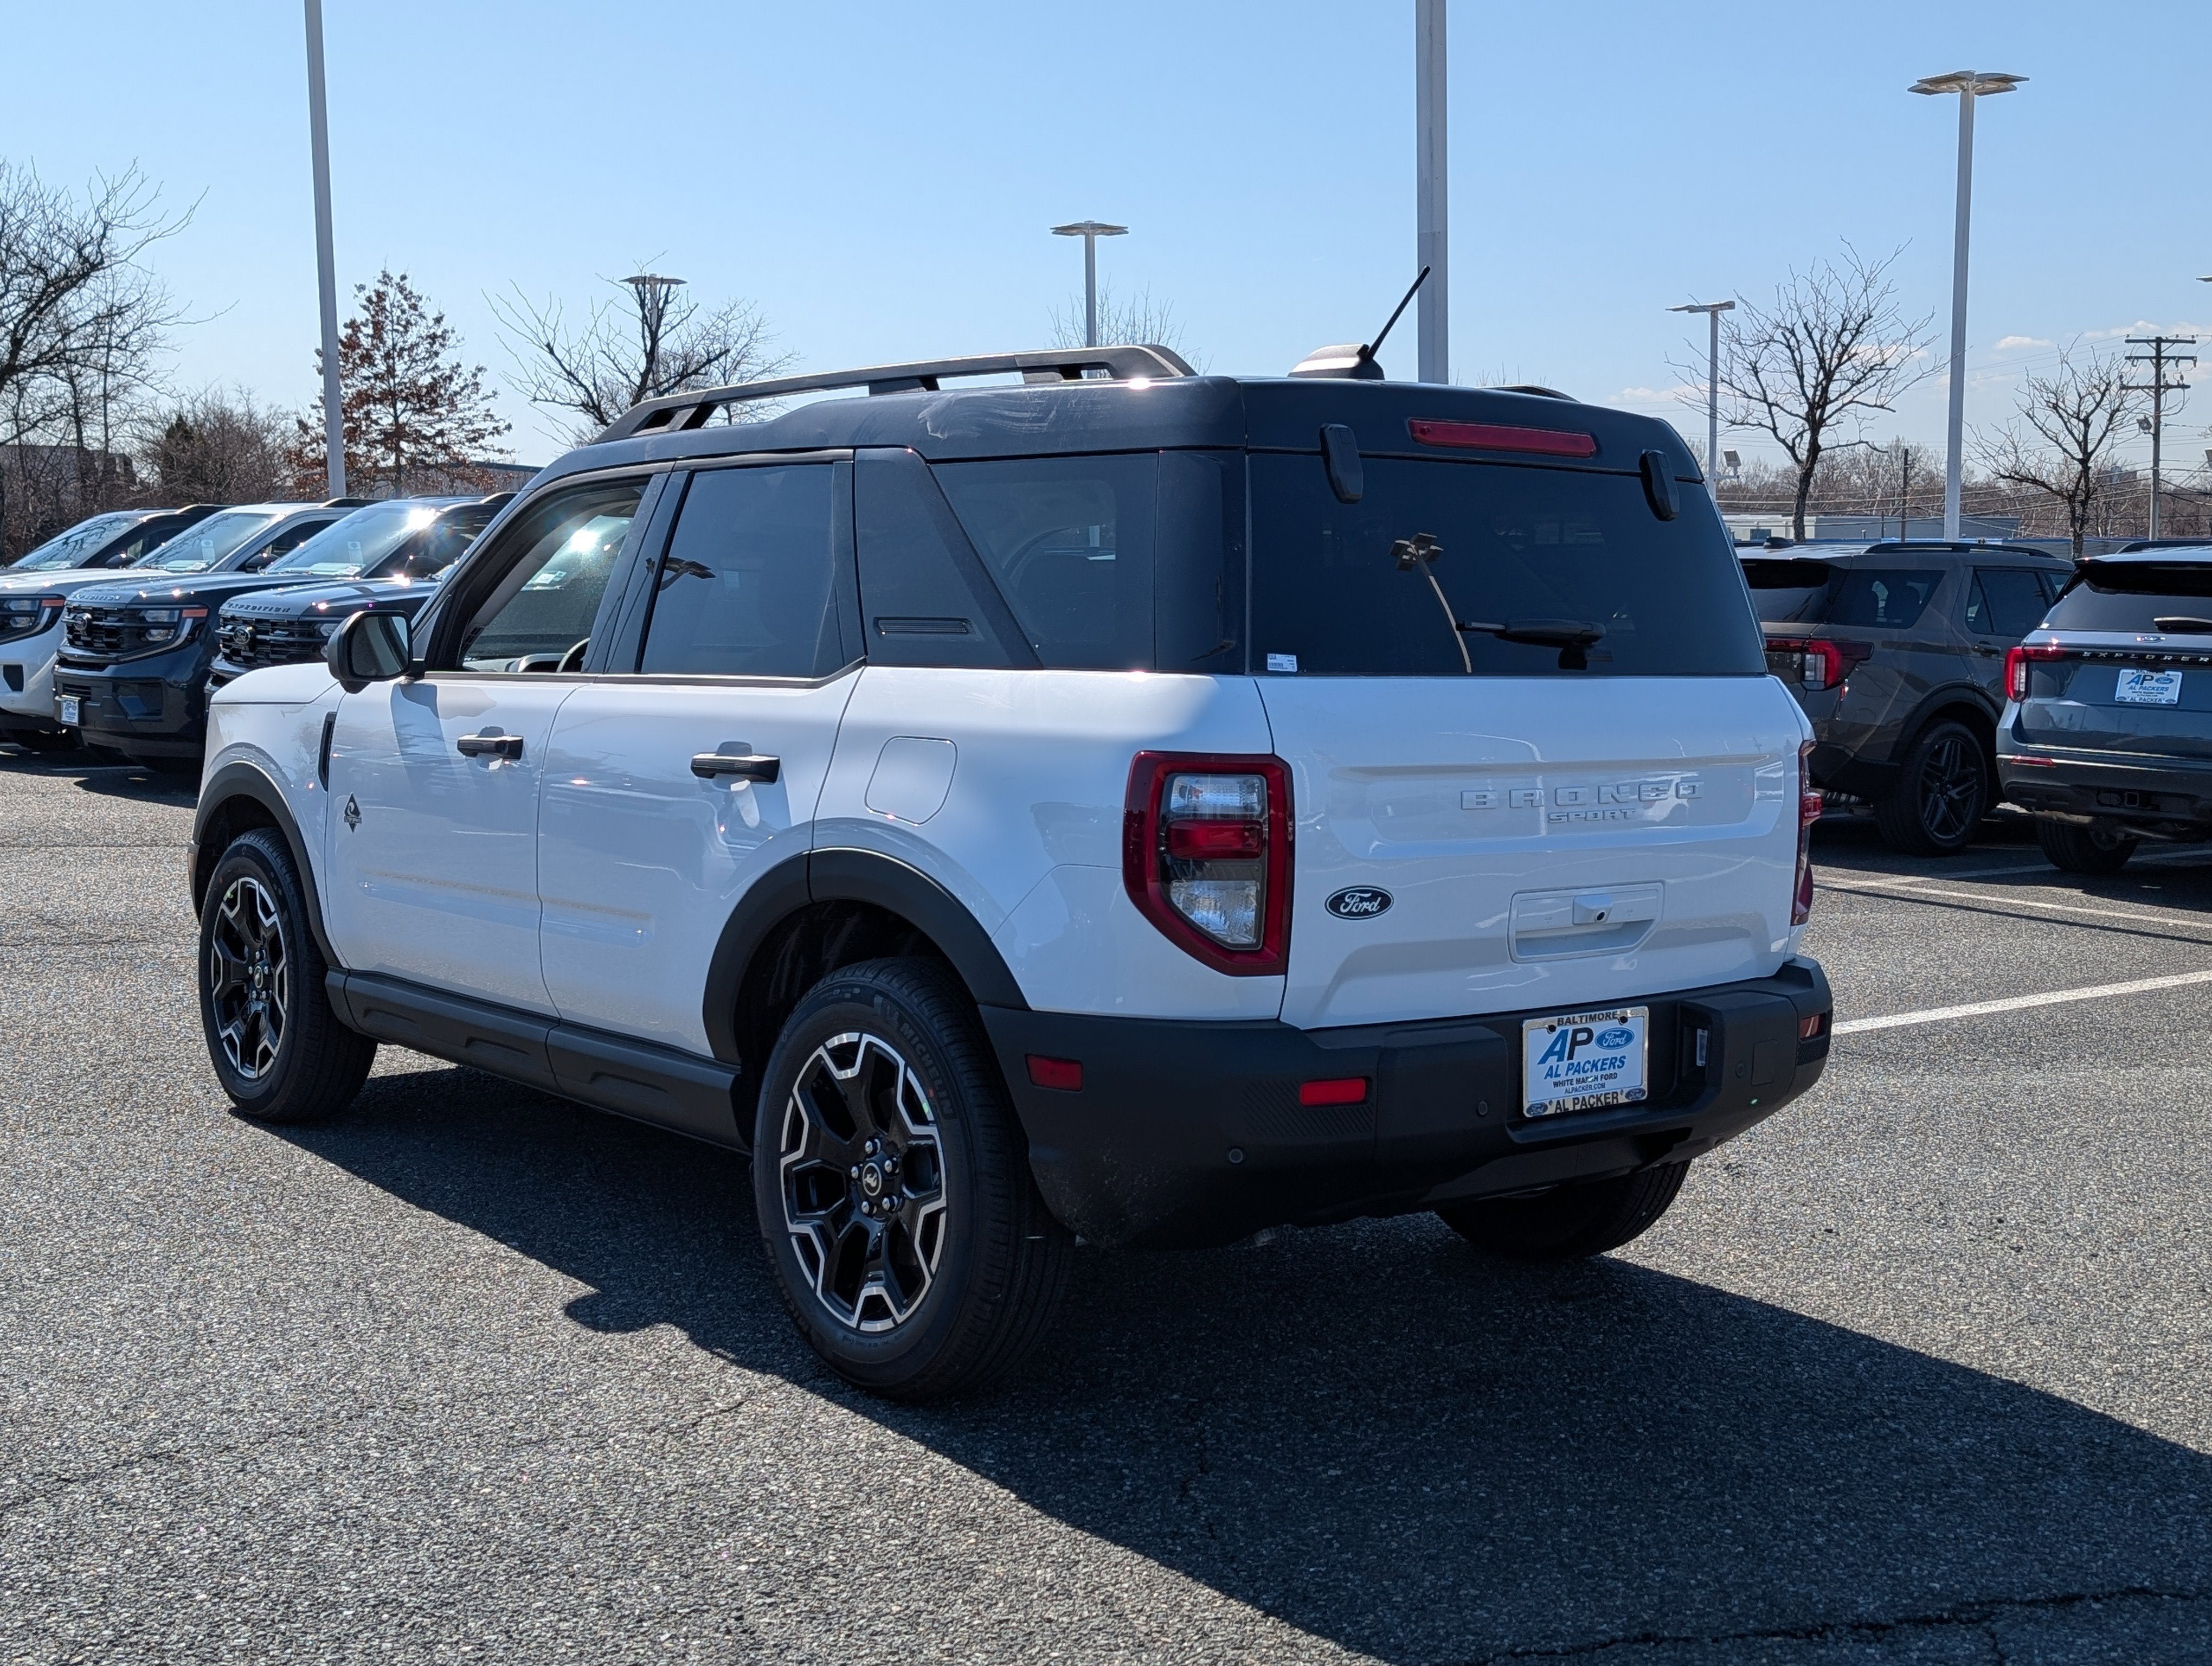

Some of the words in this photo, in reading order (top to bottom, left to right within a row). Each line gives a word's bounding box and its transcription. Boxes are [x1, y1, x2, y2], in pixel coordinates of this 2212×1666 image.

[2082, 651, 2210, 663] EXPLORER
[2125, 674, 2154, 685] AP
[1461, 780, 1705, 810] BRONCO
[1547, 808, 1636, 823] SPORT
[1340, 892, 1382, 913] Ford
[1557, 1010, 1618, 1026] BALTIMORE
[1537, 1027, 1594, 1065] AP
[899, 1022, 954, 1114] MICHELIN
[1544, 1065, 1561, 1079] AL
[1565, 1055, 1626, 1076] PACKERS
[1553, 1078, 1574, 1088] WHITE
[1576, 1075, 1598, 1084] MARH
[1600, 1072, 1618, 1081] FORD
[1564, 1082, 1606, 1094] ALPACKER.COM
[1554, 1100, 1570, 1113] AL
[1572, 1091, 1619, 1110] PACKER
